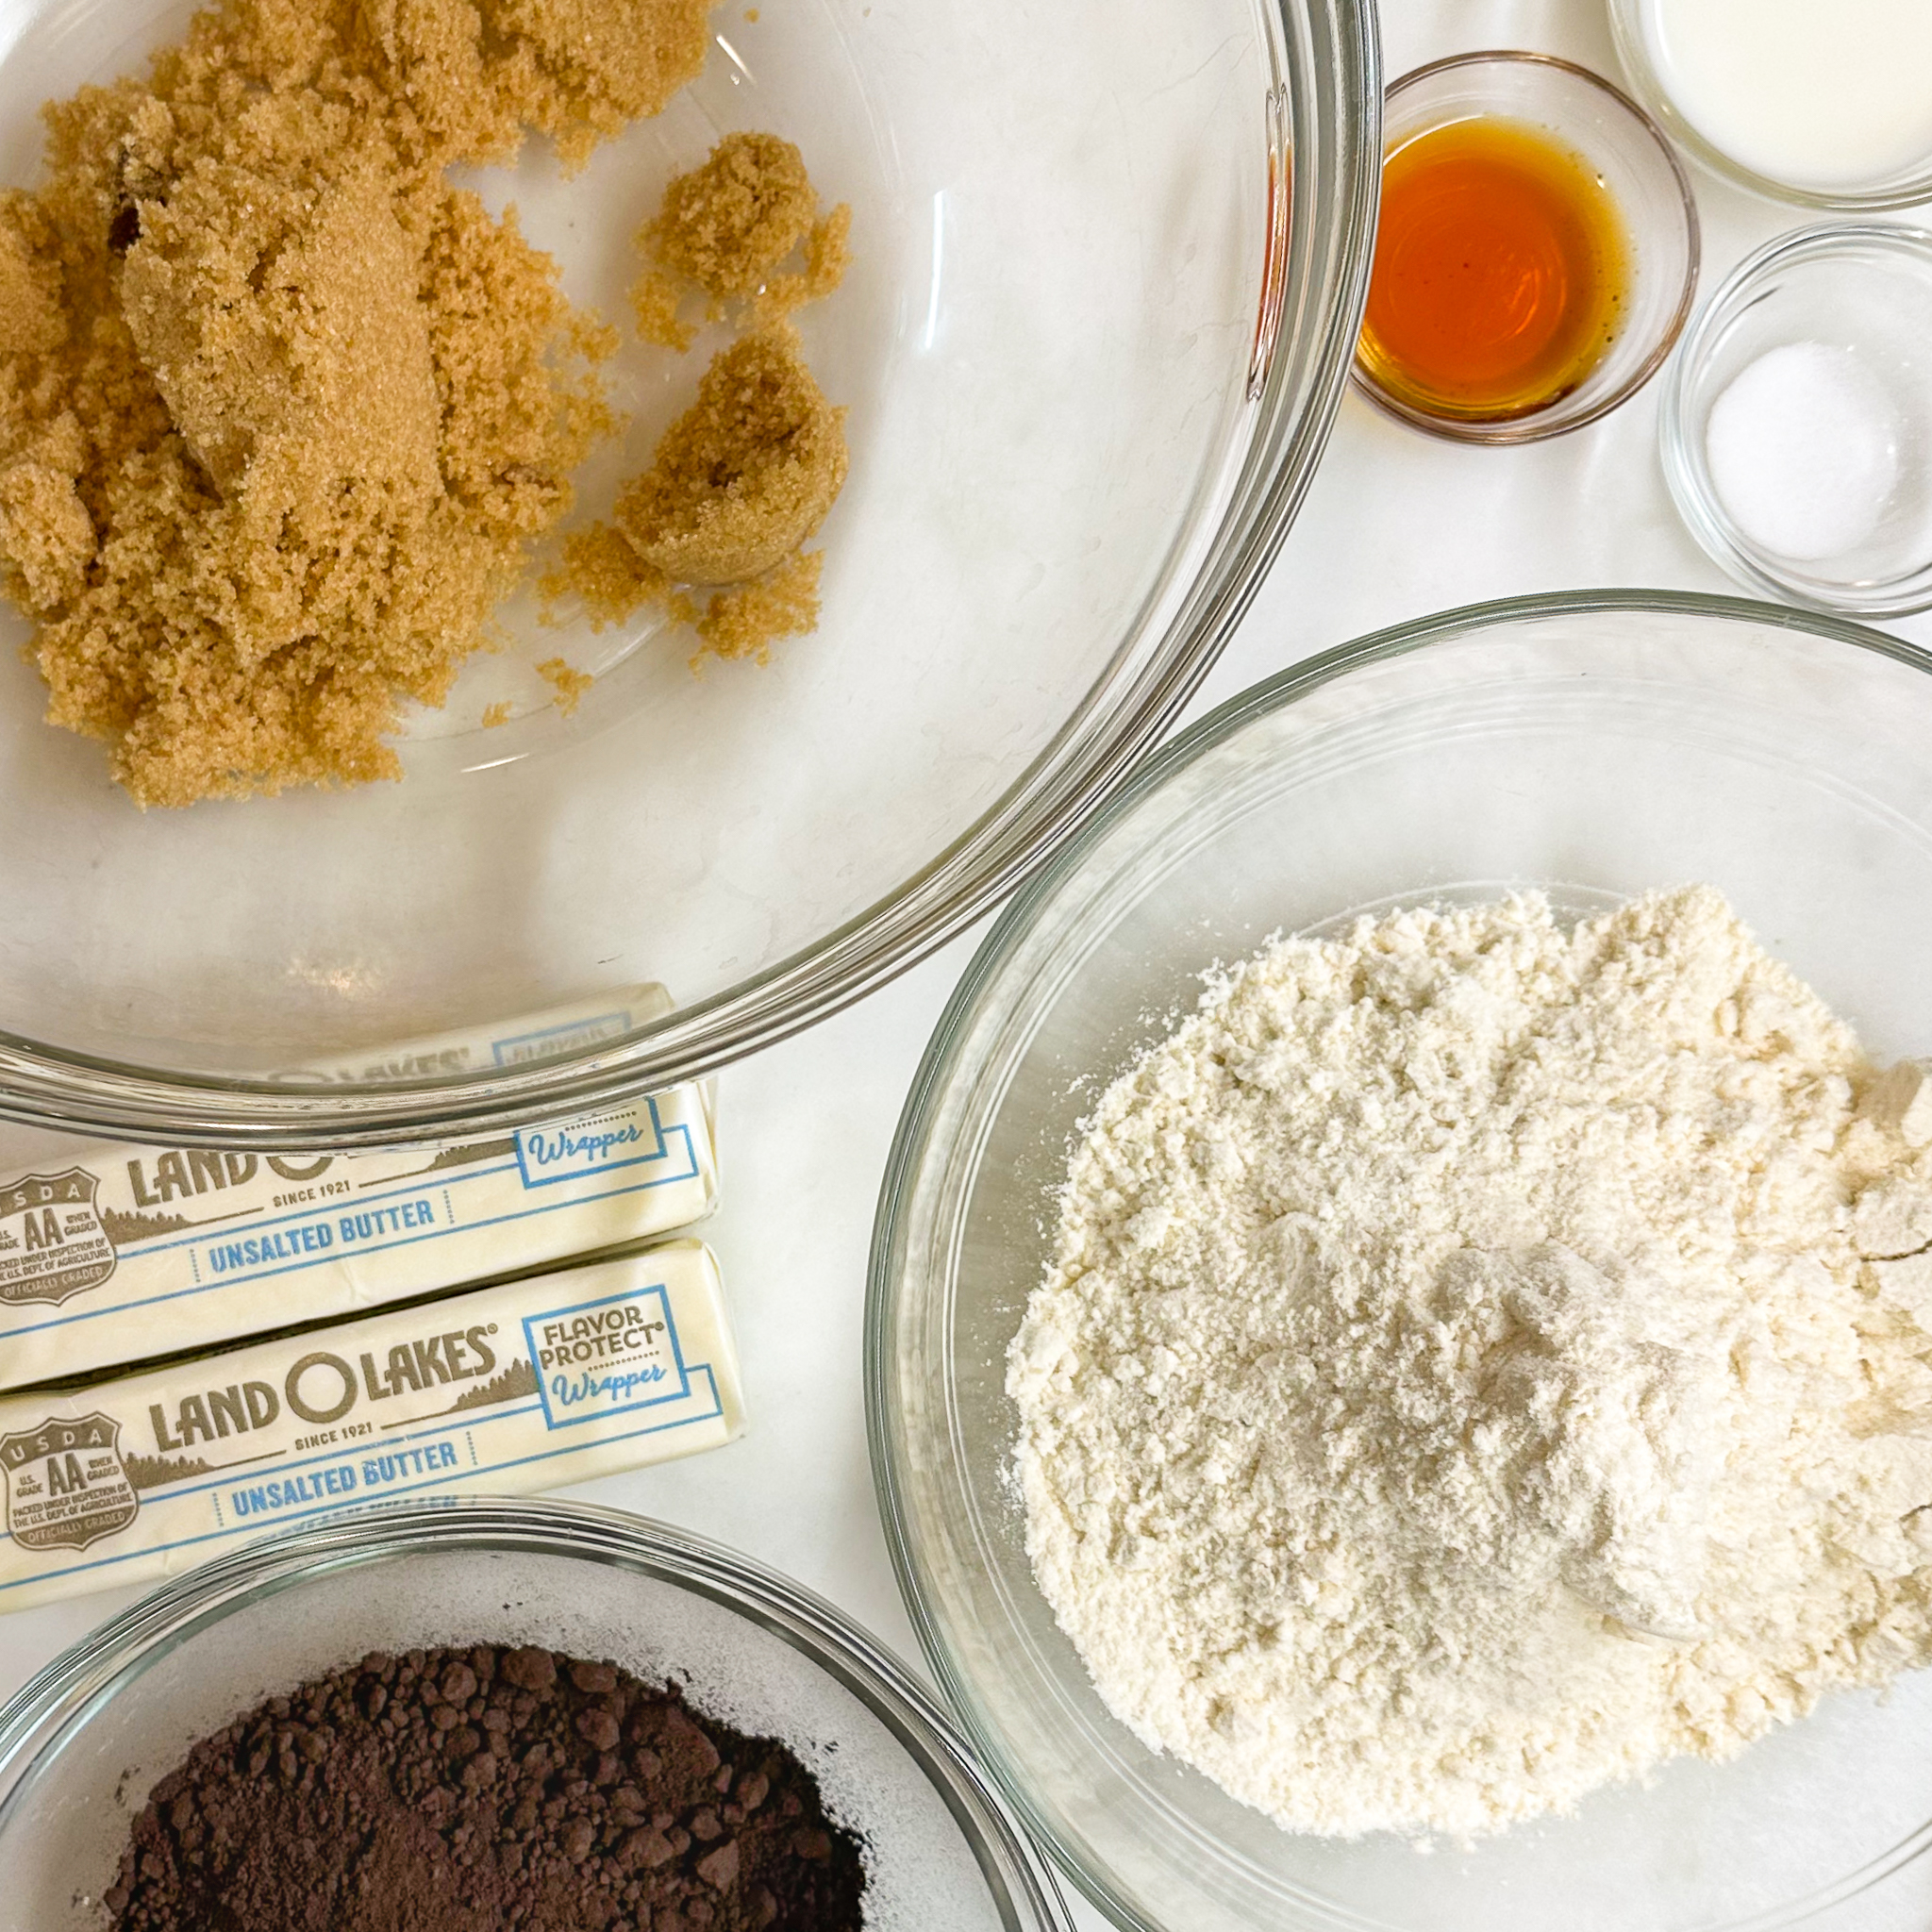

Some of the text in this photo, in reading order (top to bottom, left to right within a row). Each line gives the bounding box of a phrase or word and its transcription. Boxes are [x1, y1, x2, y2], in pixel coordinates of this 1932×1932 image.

[528, 1124, 644, 1166] Wrapper
[127, 1150, 258, 1208] LAND
[273, 1180, 351, 1208] SINCE 1921
[13, 1183, 81, 1208] SDA
[25, 1208, 65, 1252] AA
[63, 1221, 98, 1236] GRADED
[94, 1238, 106, 1248] OF
[208, 1199, 434, 1273] UNSALTED BUTTER
[61, 1266, 103, 1284] GRADED
[543, 1305, 643, 1346] FLAVOR
[552, 1363, 668, 1407] Wrapper
[148, 1380, 280, 1453] LAND
[285, 1351, 359, 1424] O
[294, 1422, 374, 1452] SINCE 1921
[47, 1453, 88, 1497] AA
[87, 1465, 120, 1481] GRADED
[117, 1481, 128, 1492] OF
[232, 1465, 357, 1516] UNSALTED
[360, 1441, 458, 1487] BUTTER
[16, 1483, 43, 1498] GRADE
[68, 1504, 79, 1515] OF
[28, 1511, 125, 1542] OFFICIALLY GRADED
